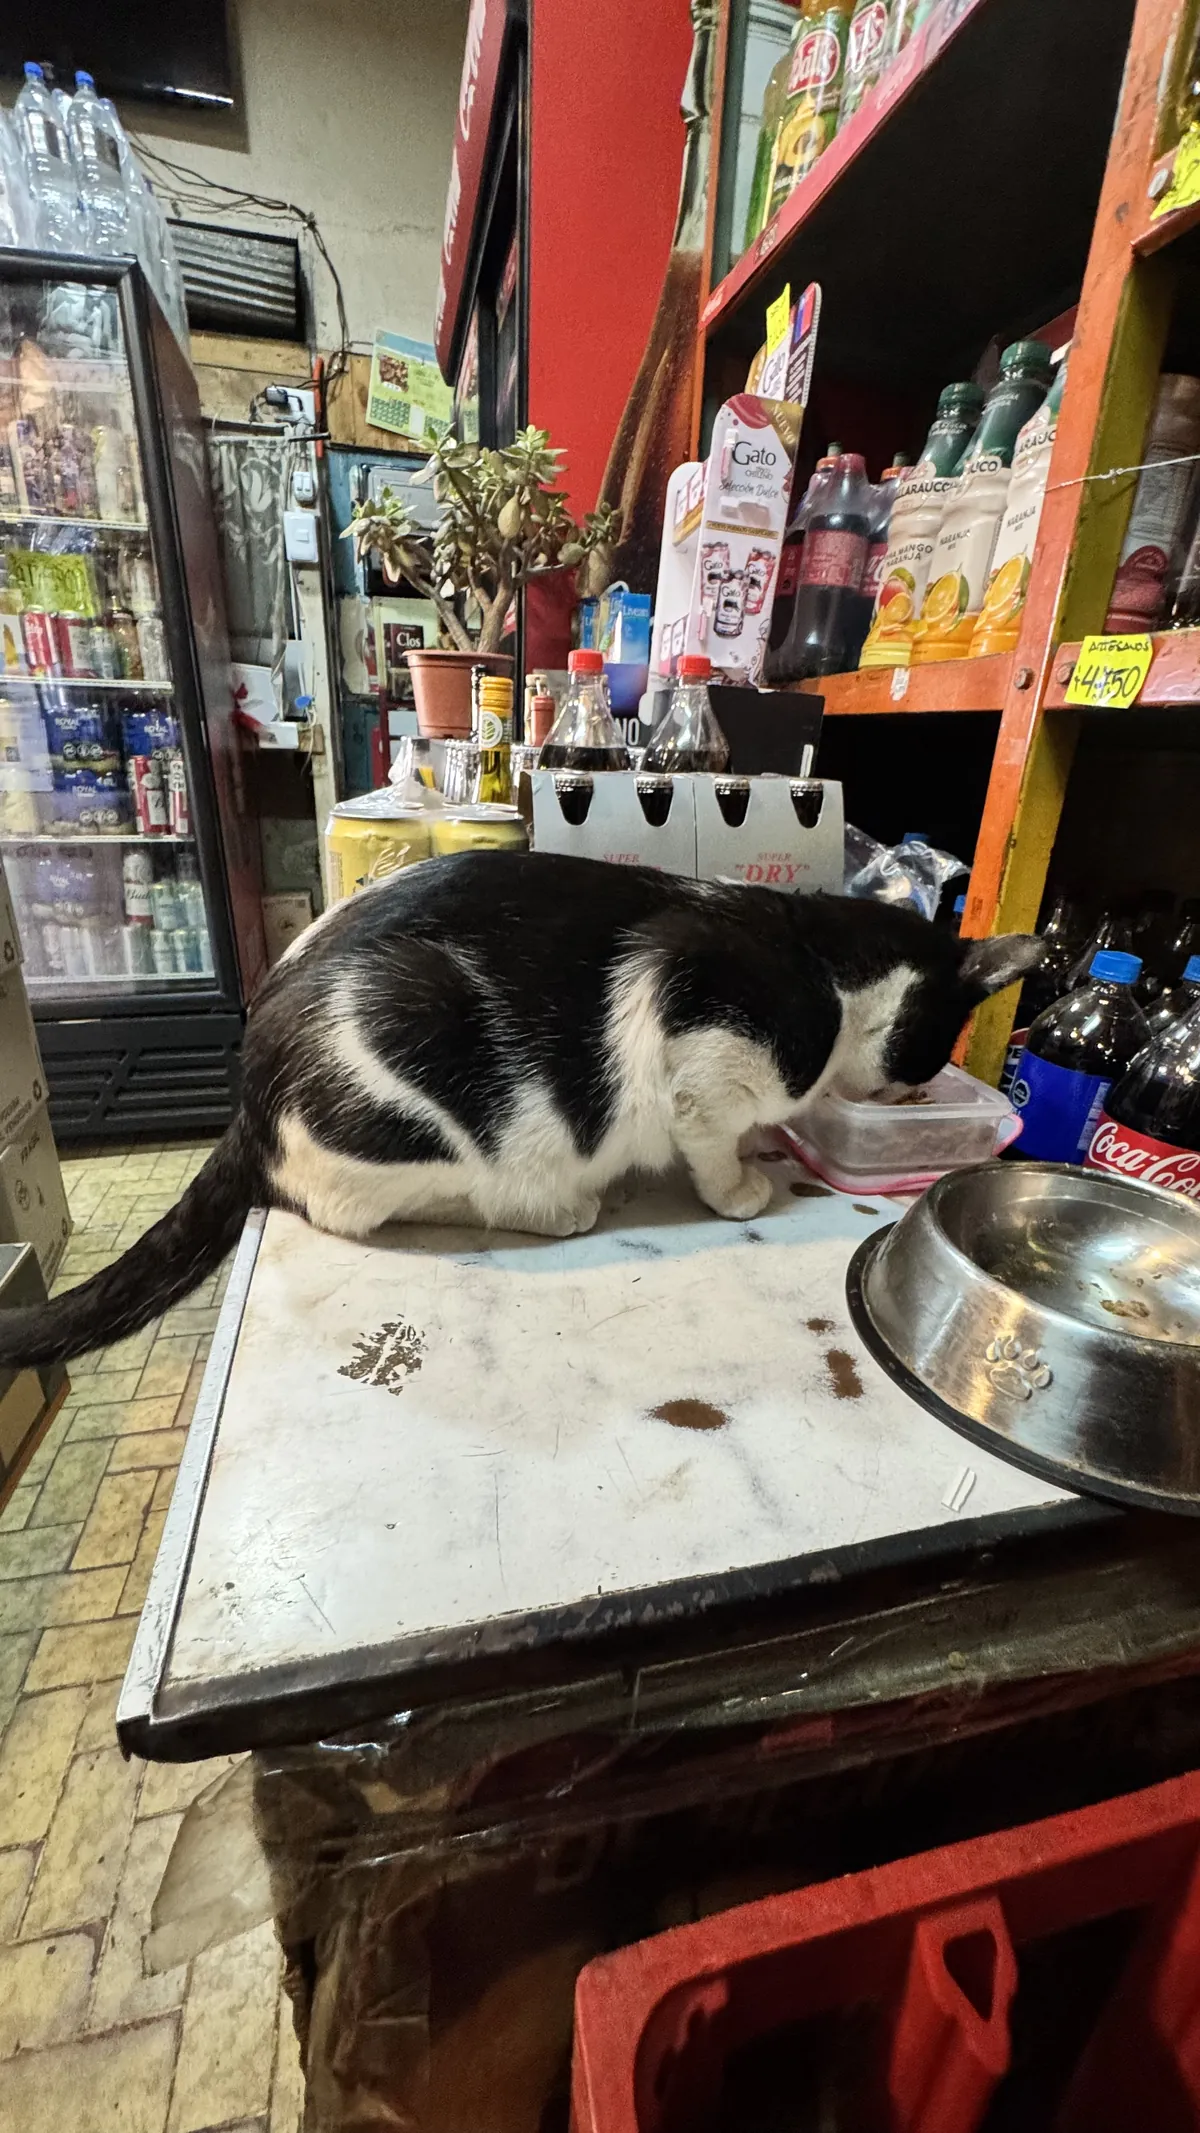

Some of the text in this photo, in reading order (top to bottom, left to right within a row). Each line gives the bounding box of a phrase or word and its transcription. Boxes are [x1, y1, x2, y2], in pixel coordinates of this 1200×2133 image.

[773, 403, 796, 445] NUEVO
[732, 441, 777, 466] Gato
[898, 543, 934, 555] MANGO
[396, 632, 421, 647] Clos
[603, 853, 640, 864] SUPER
[757, 852, 792, 862] SUPER
[1088, 1121, 1200, 1198] Coca-Co
